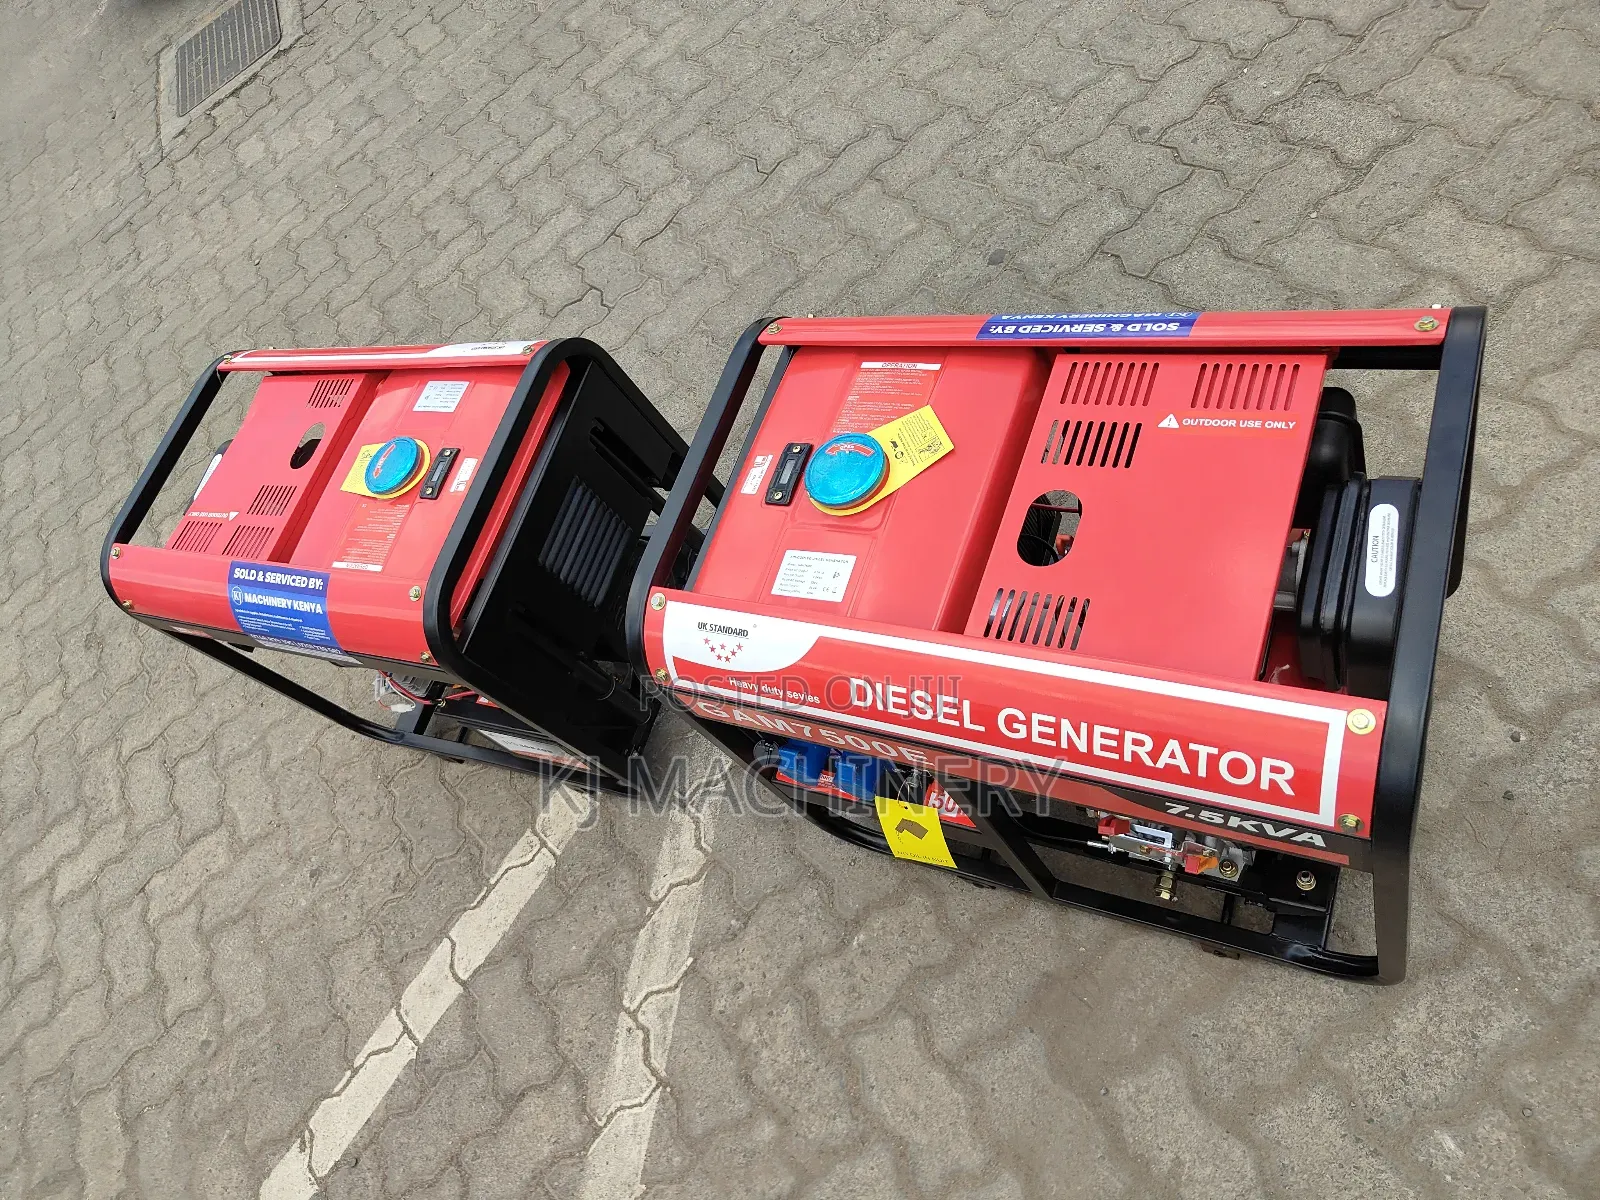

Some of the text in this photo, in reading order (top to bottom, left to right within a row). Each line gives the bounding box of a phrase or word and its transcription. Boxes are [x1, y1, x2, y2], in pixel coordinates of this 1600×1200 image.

[989, 322, 1180, 334] SOLD & SERVICED BY:
[1182, 418, 1297, 430] OUTDOOR USE ONLY
[1370, 535, 1380, 563] CAUTION
[233, 567, 324, 591] SOLD & SERVICED BY:
[244, 592, 293, 610] MACHINERY
[293, 599, 324, 614] KENYA
[697, 621, 749, 638] UK STANDARD
[728, 677, 759, 692] Heavy
[761, 682, 784, 699] duty
[850, 677, 1297, 797] DIESEL GENERATOR
[1164, 801, 1328, 848] 7.5KVA
